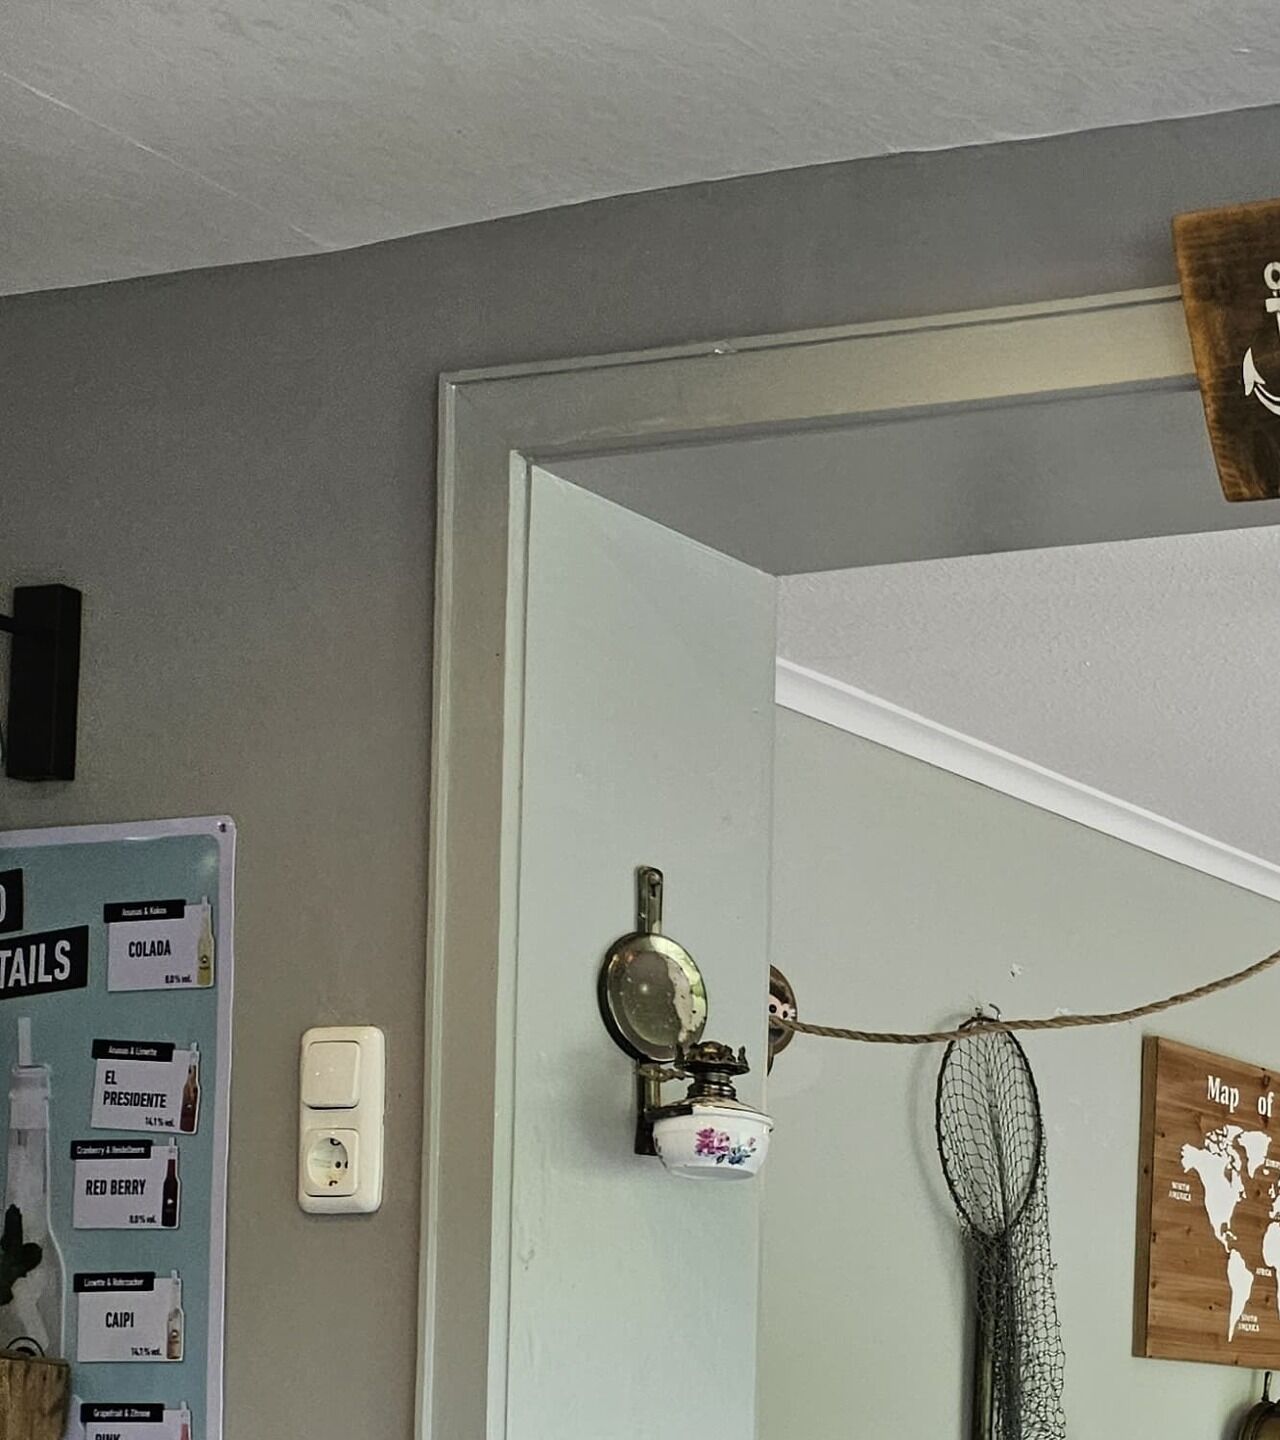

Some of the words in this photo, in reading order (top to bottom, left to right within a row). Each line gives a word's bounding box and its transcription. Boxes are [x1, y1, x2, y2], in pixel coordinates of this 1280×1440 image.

[128, 940, 171, 958] COLADA
[104, 1070, 117, 1085] EL
[103, 1091, 167, 1108] PRESIDENTE
[1207, 1075, 1240, 1113] Map
[1257, 1091, 1275, 1118] of
[86, 1179, 107, 1195] RED
[110, 1179, 146, 1195] BERRY
[105, 1312, 134, 1328] CAIPI
